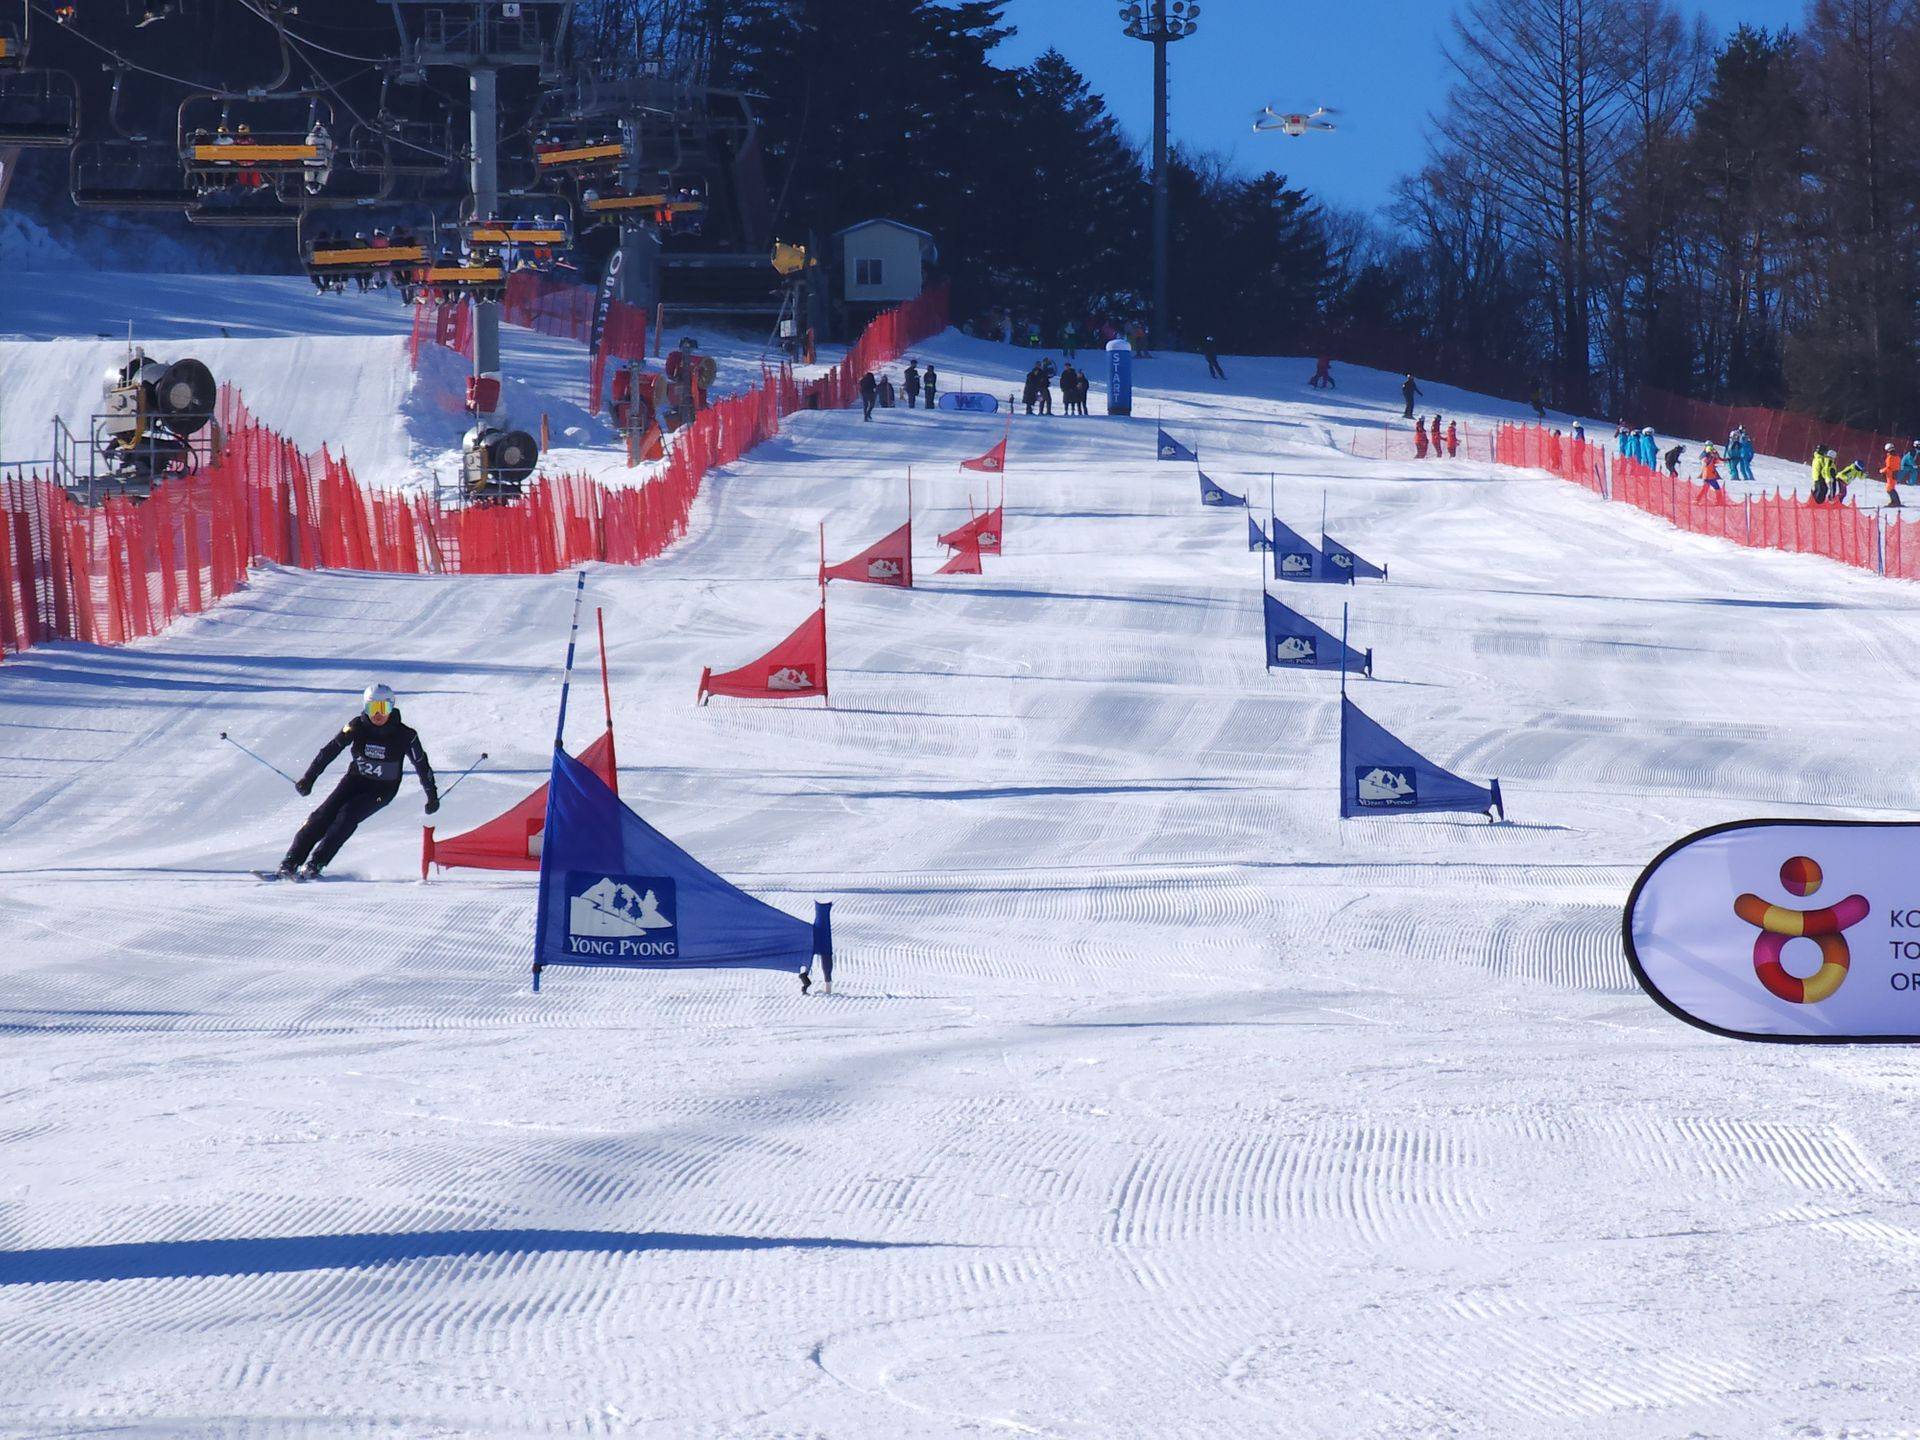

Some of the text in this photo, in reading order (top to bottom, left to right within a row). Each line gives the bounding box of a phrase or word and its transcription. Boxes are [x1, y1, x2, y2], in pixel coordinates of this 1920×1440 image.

[569, 936, 675, 956] YONG PYONG
[1889, 941, 1920, 959] TO
